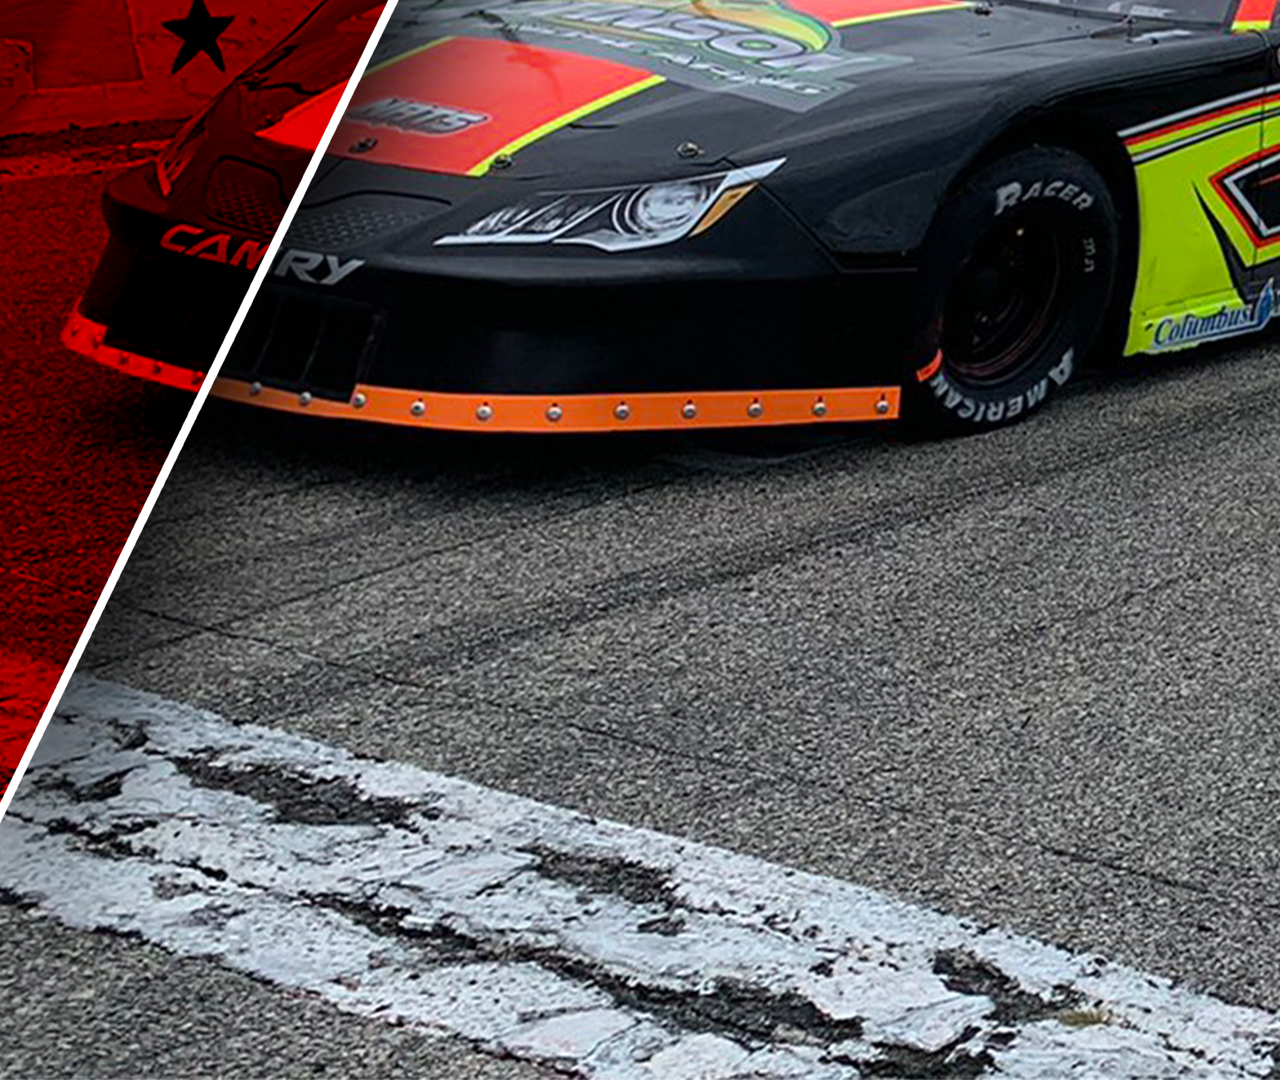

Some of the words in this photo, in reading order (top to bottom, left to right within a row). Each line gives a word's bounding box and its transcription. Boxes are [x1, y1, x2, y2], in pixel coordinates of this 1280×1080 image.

[994, 180, 1095, 216] RACER
[160, 223, 364, 286] CAMRY
[1154, 304, 1252, 347] Columbus
[930, 347, 1074, 421] AMERICAN
